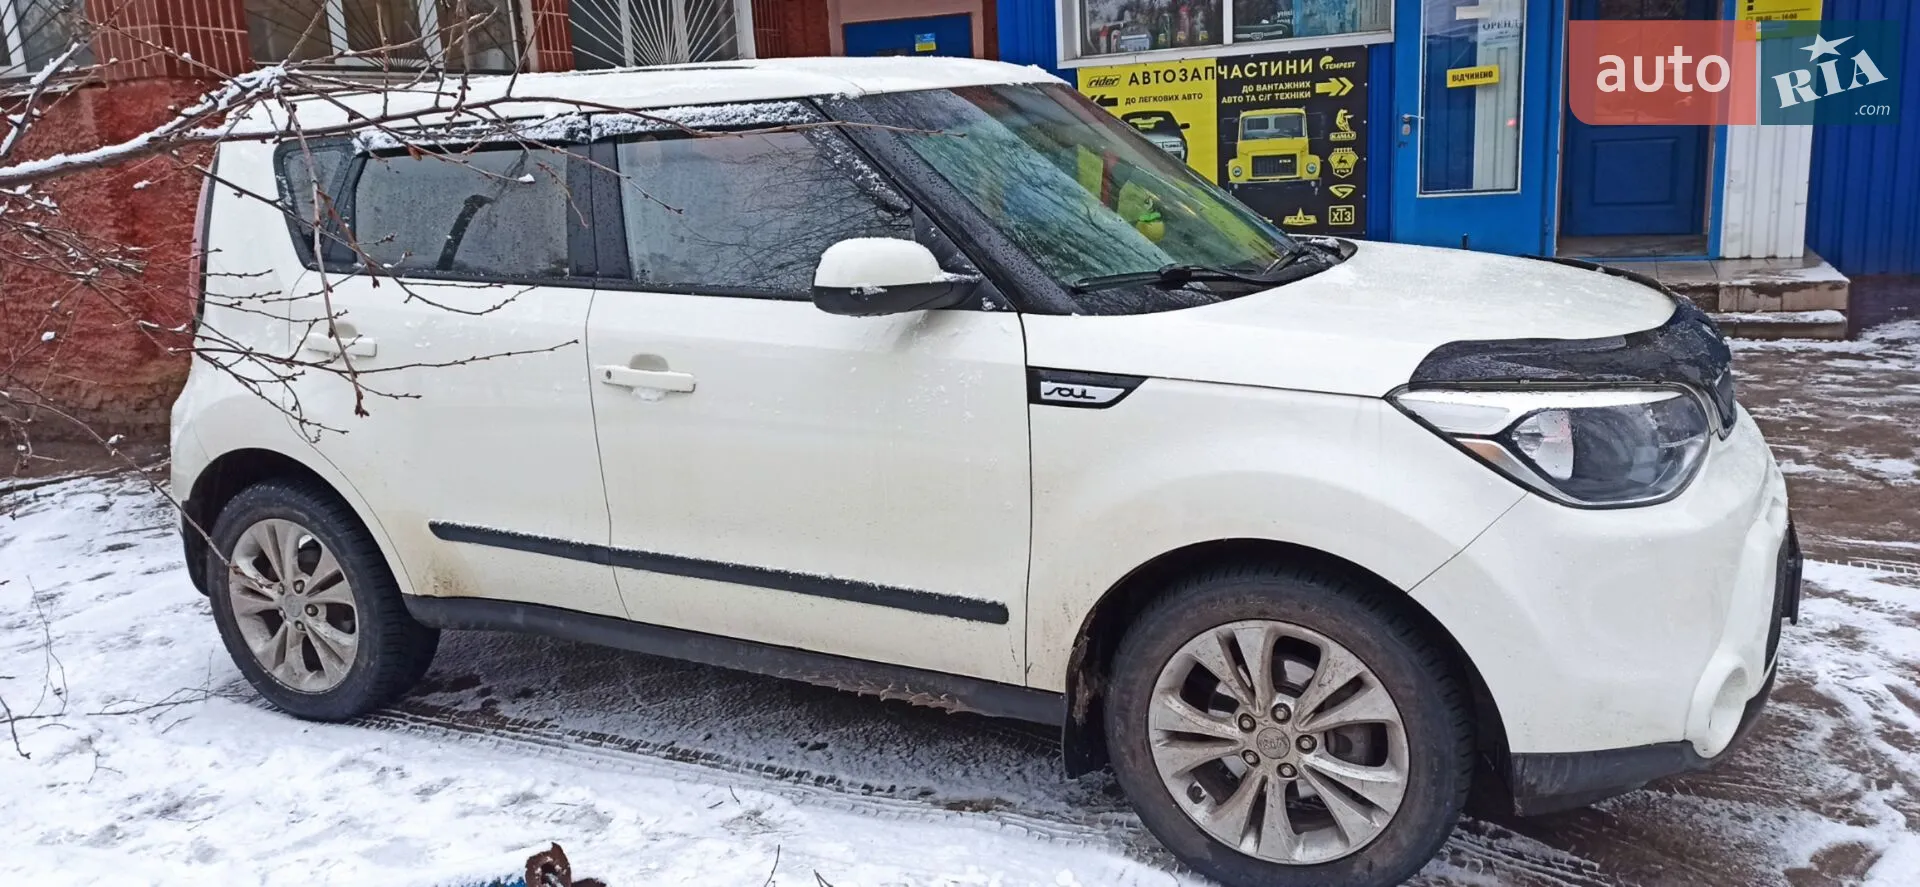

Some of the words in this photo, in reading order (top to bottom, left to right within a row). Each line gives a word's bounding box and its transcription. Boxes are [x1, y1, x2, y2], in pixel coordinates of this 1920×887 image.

[1325, 62, 1356, 70] TEMPEST
[1088, 76, 1120, 87] rider
[1452, 70, 1493, 81] ВІДЧИНЕНО
[1242, 85, 1254, 94] ДО
[1256, 81, 1311, 92] ВАНТАЖНИХ
[1125, 97, 1136, 105] ДО
[1138, 95, 1180, 103] ЛЕГКОВИХ
[1181, 92, 1203, 101] АВТО
[1221, 96, 1244, 104] АВТО
[1258, 93, 1272, 102] С/Г
[1275, 91, 1311, 100] ТЕХНІКИ
[1044, 386, 1096, 399] SOUL
